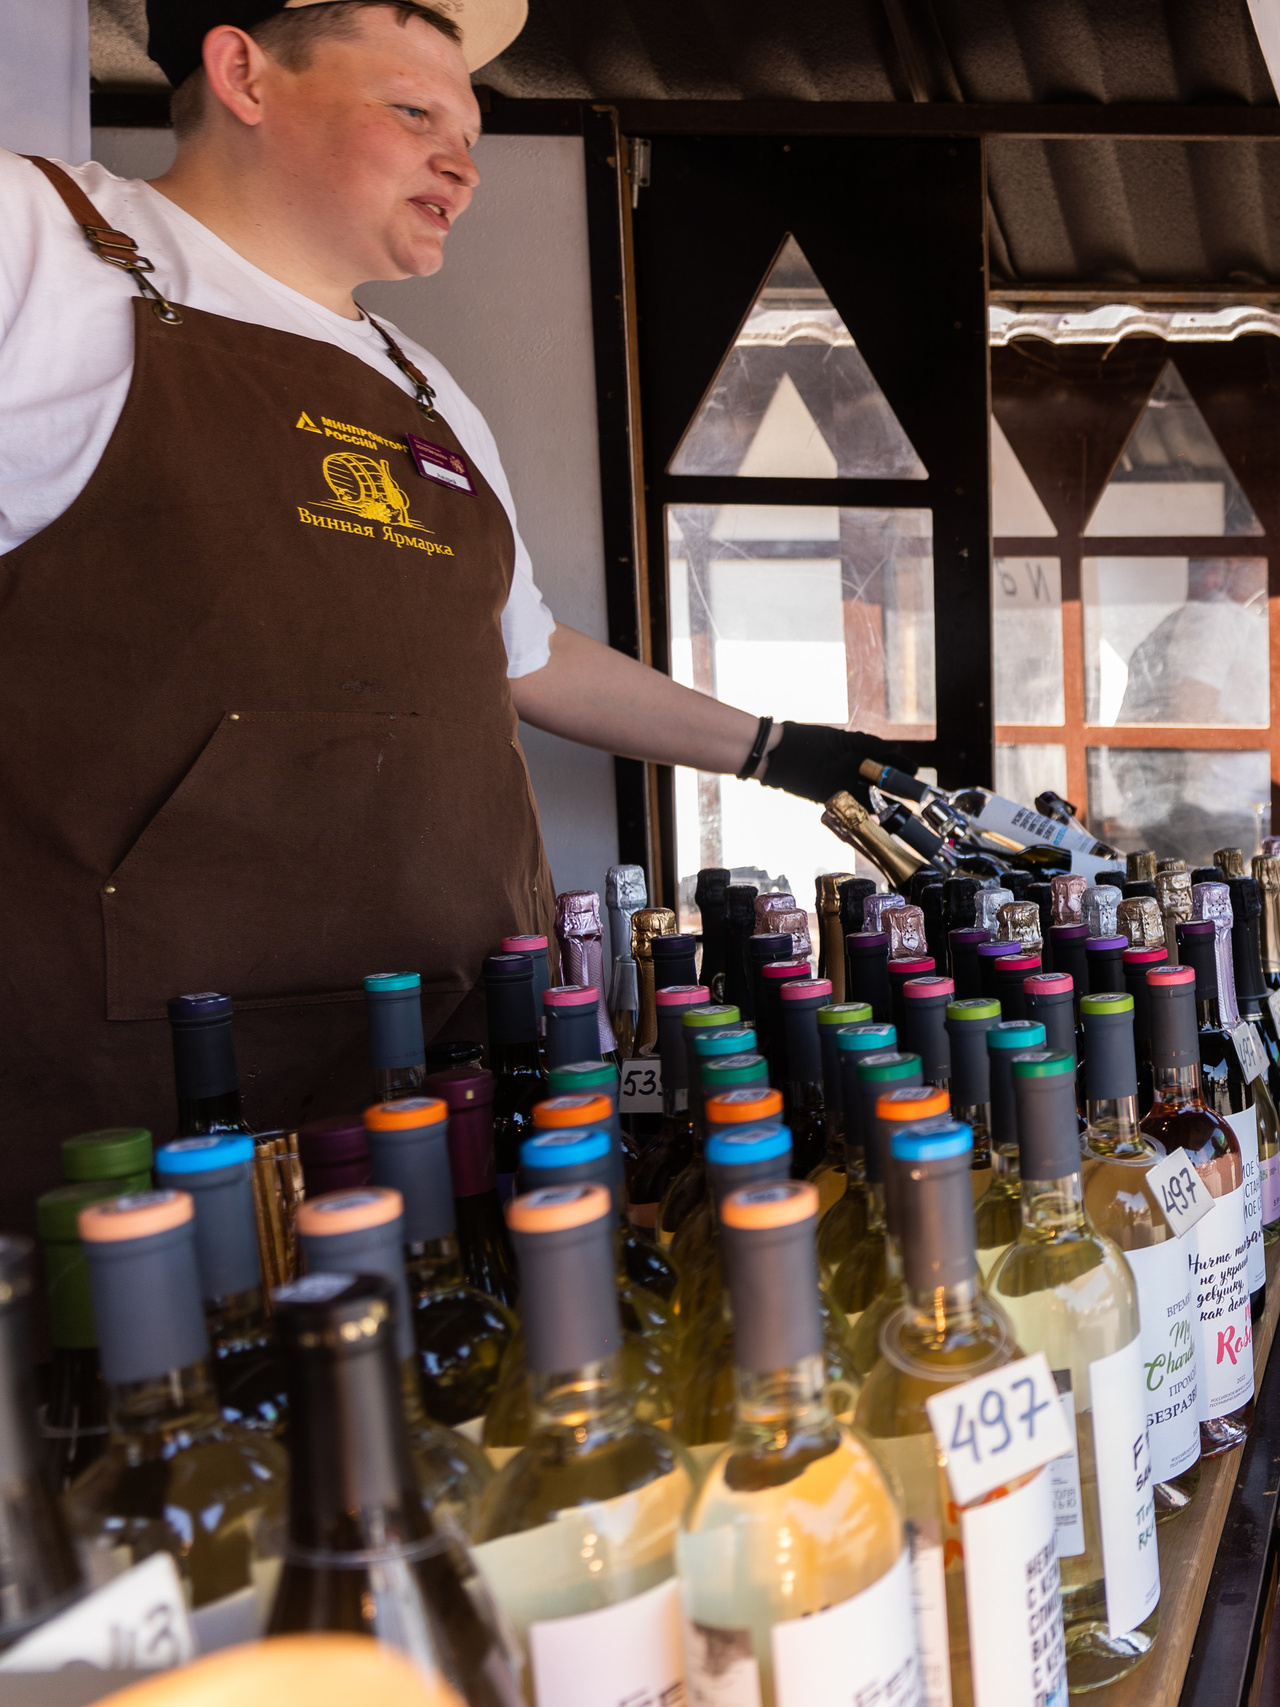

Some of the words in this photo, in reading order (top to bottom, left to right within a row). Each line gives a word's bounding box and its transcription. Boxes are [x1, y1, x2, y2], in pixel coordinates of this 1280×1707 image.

[320, 415, 410, 454] МИНПРОМТОРГ
[325, 427, 378, 451] РОССИИ
[297, 506, 376, 539] Винная
[382, 525, 456, 558] Ярмарка
[623, 1069, 664, 1097] 53
[1161, 1166, 1197, 1216] 497
[1188, 1252, 1232, 1276] Ничто
[1200, 1273, 1216, 1286] не
[1200, 1307, 1224, 1322] как
[951, 1377, 1049, 1463] 497
